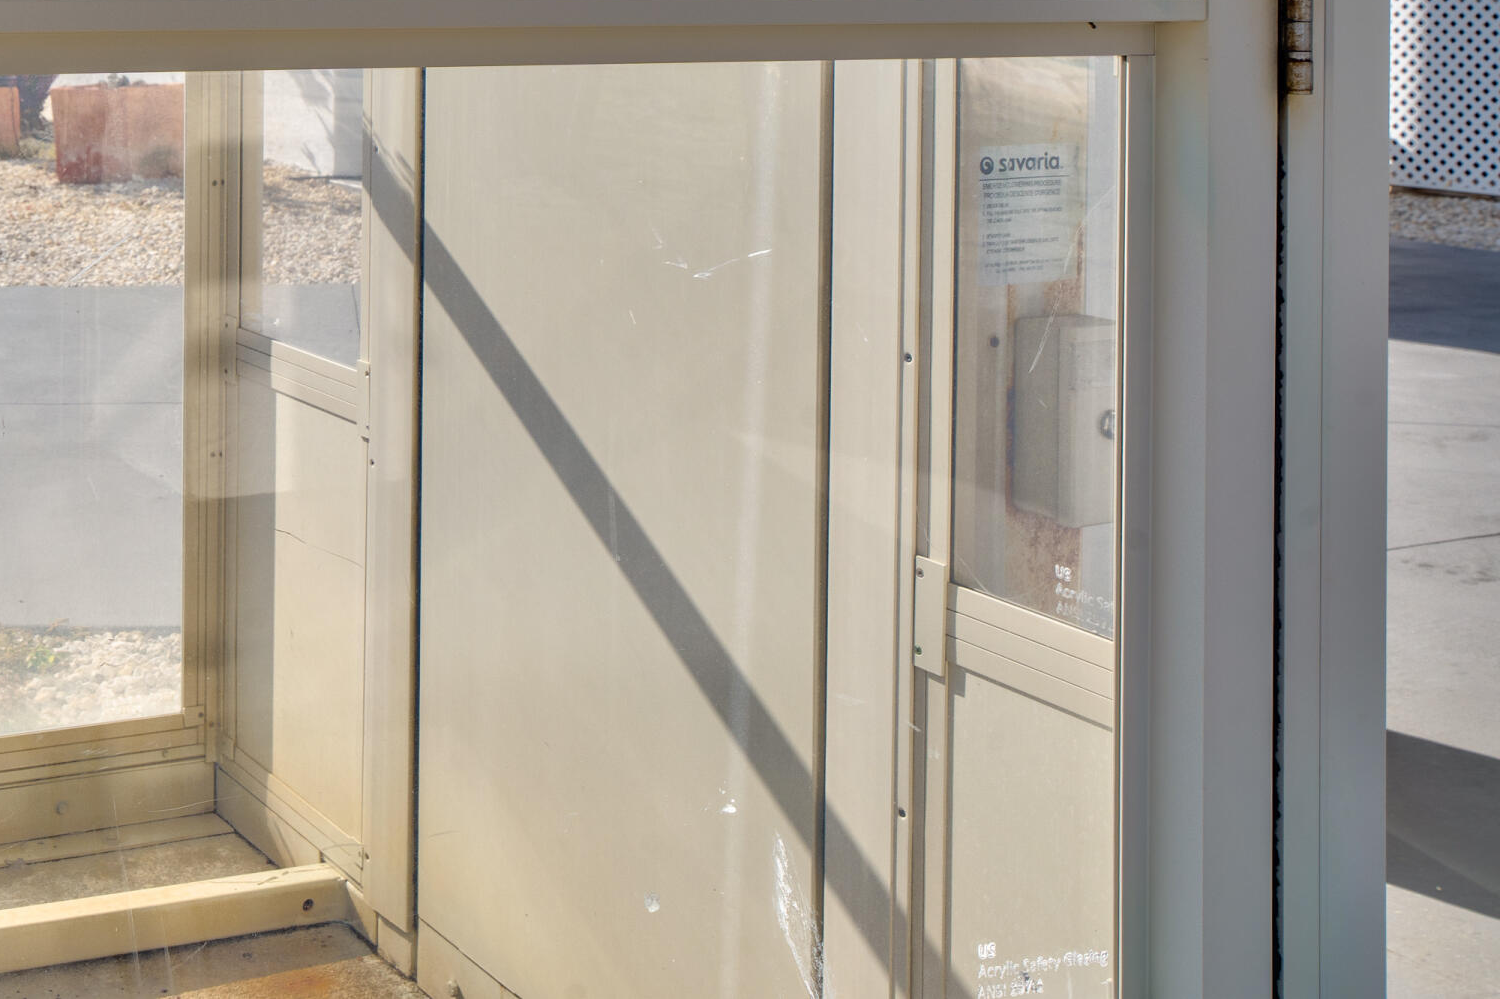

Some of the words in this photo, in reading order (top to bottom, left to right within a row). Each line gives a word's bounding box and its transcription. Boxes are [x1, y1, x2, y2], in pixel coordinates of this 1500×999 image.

[978, 942, 996, 959] US
[978, 961, 1019, 979] Acrylic
[1022, 956, 1061, 972] Safety
[1063, 950, 1108, 967] Glazing
